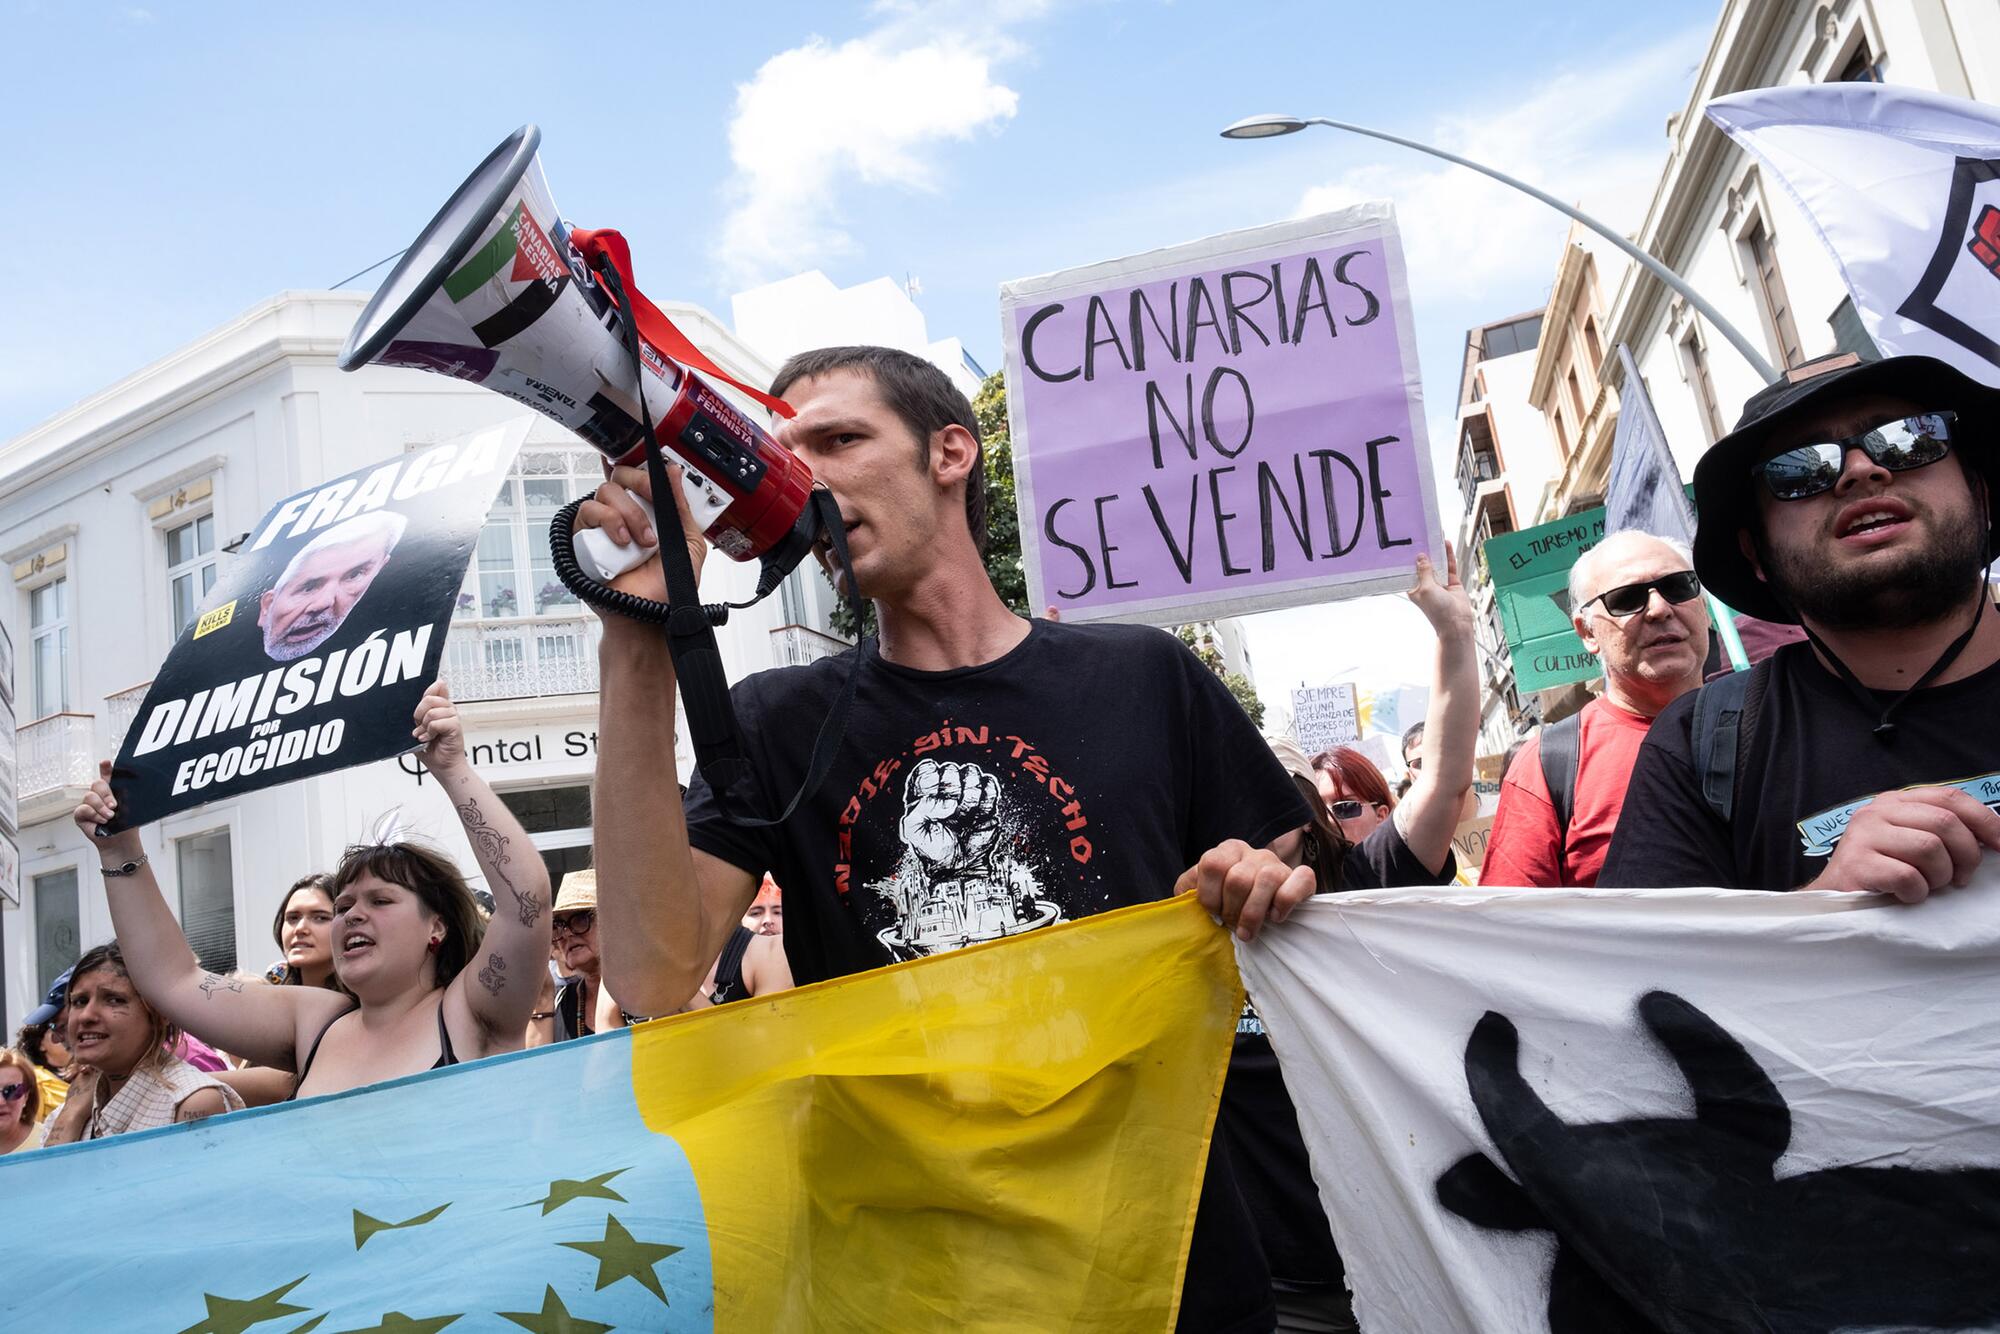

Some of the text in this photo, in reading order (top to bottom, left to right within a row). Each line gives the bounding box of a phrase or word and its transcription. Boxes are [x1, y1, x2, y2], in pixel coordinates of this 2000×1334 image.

[510, 221, 558, 294] PALESTINA
[519, 212, 561, 279] CANARIAS
[1022, 251, 1380, 382] CANARIAS
[697, 394, 753, 447] FEMINISTA
[701, 388, 755, 437] CANARIAS
[1146, 366, 1254, 468] NO
[250, 427, 507, 552] FRAGA
[1044, 436, 1413, 599] SE VENDE
[1509, 518, 1606, 570] EL TURISMO M
[133, 623, 434, 757] DIMISIÓN
[1296, 701, 1334, 714] HAY UNA
[1297, 686, 1346, 705] SIEMPRE
[1297, 708, 1355, 723] ESPERANZA DE
[171, 719, 346, 796] ECOCIDIO
[251, 719, 281, 739] POR
[1299, 719, 1355, 733] HOMBRES CON
[1006, 735, 1093, 865] TECHO
